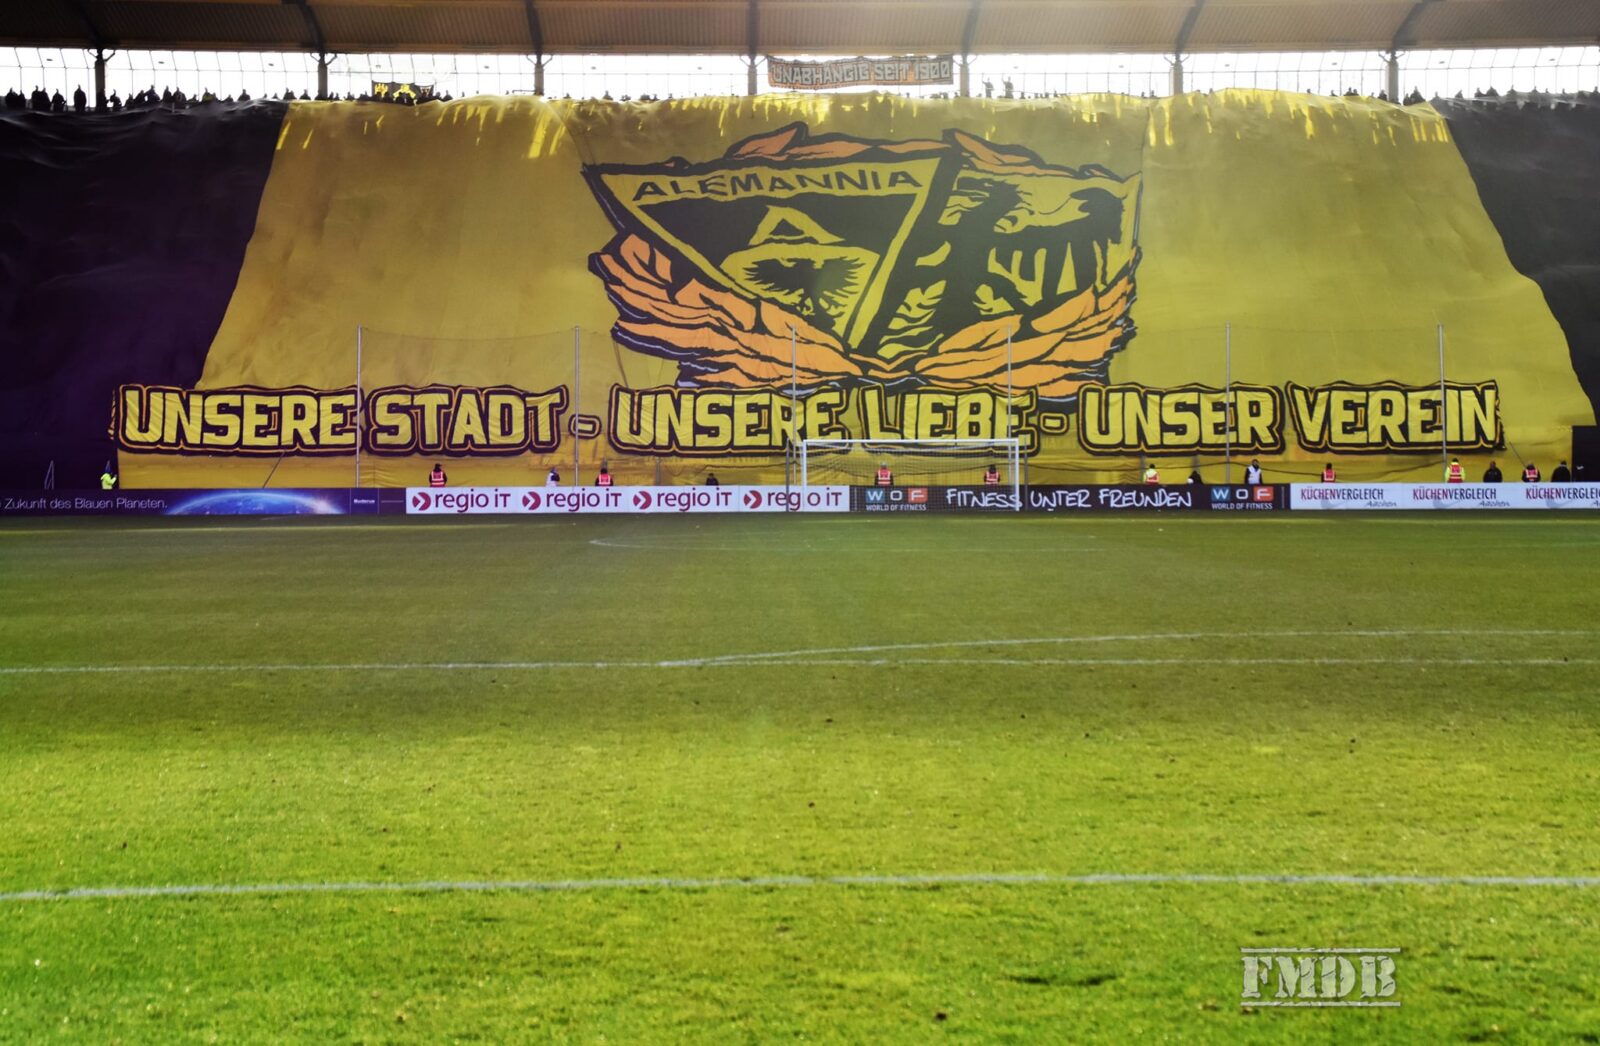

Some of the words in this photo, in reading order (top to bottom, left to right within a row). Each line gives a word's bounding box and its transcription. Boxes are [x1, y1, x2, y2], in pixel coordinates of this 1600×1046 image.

[873, 62, 910, 81] SEIT
[914, 60, 951, 80] 1900
[632, 169, 923, 201] ALEMANNIA
[122, 389, 359, 448] UNSERE
[375, 391, 563, 448] STADT
[613, 389, 848, 449] UNSERE
[868, 390, 1026, 448] LIEBE
[1084, 388, 1278, 446] UNSER
[1296, 387, 1497, 445] VEREIN
[434, 488, 489, 513] regio
[546, 488, 600, 512] regio
[657, 487, 711, 512] regio
[767, 491, 821, 511] rego
[946, 488, 1023, 508] FITNESS
[1030, 489, 1092, 509] UNTER
[1098, 488, 1192, 508] FREUNDEN
[1301, 486, 1384, 500] KÜCHENVERGLEICH
[1412, 486, 1496, 500] KÜCHENVERGLEICH
[1525, 485, 1600, 500] KÜCHENVERGLEI
[4, 498, 47, 510] Zukunft
[50, 498, 72, 510] des
[75, 498, 113, 510] Blauen
[900, 503, 927, 511] FITNESS
